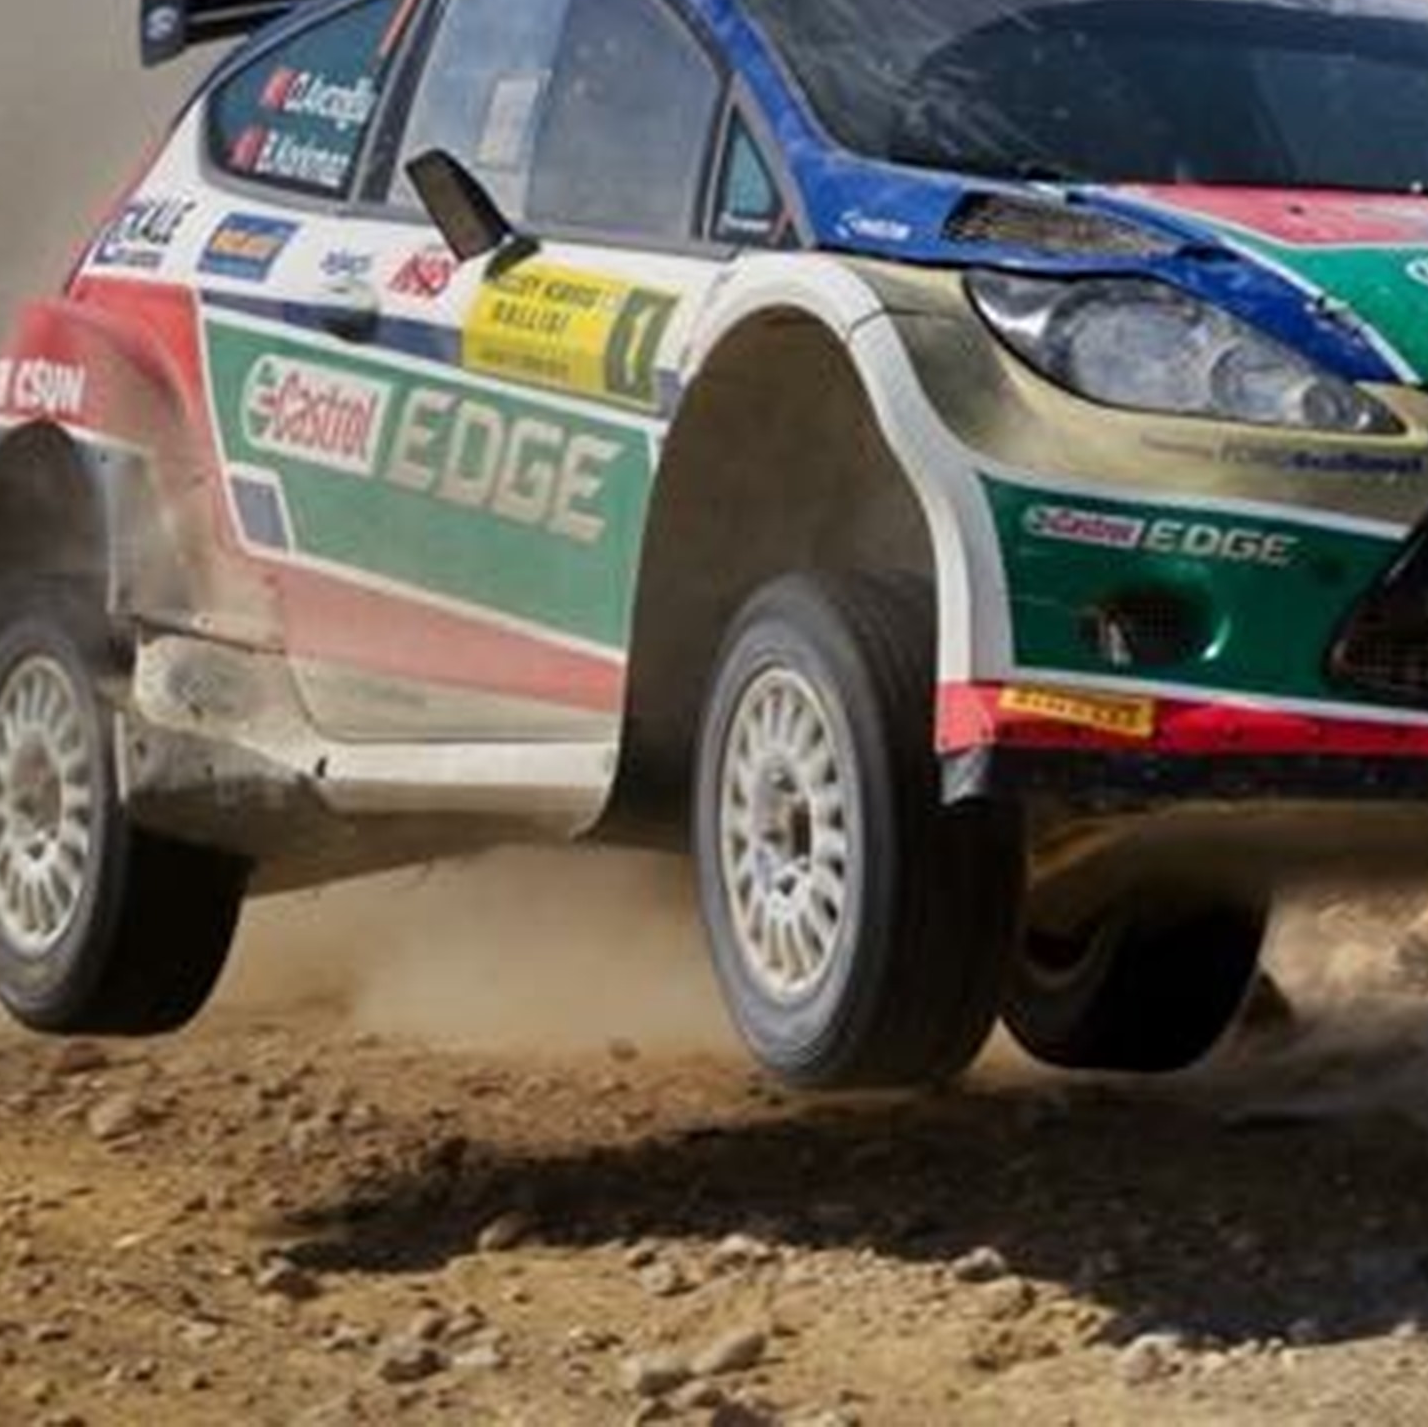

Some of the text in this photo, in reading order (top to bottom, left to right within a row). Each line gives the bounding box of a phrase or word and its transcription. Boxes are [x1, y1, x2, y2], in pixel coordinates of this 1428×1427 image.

[272, 371, 625, 545] Castrol EDGE
[1142, 518, 1300, 566] EDGE
